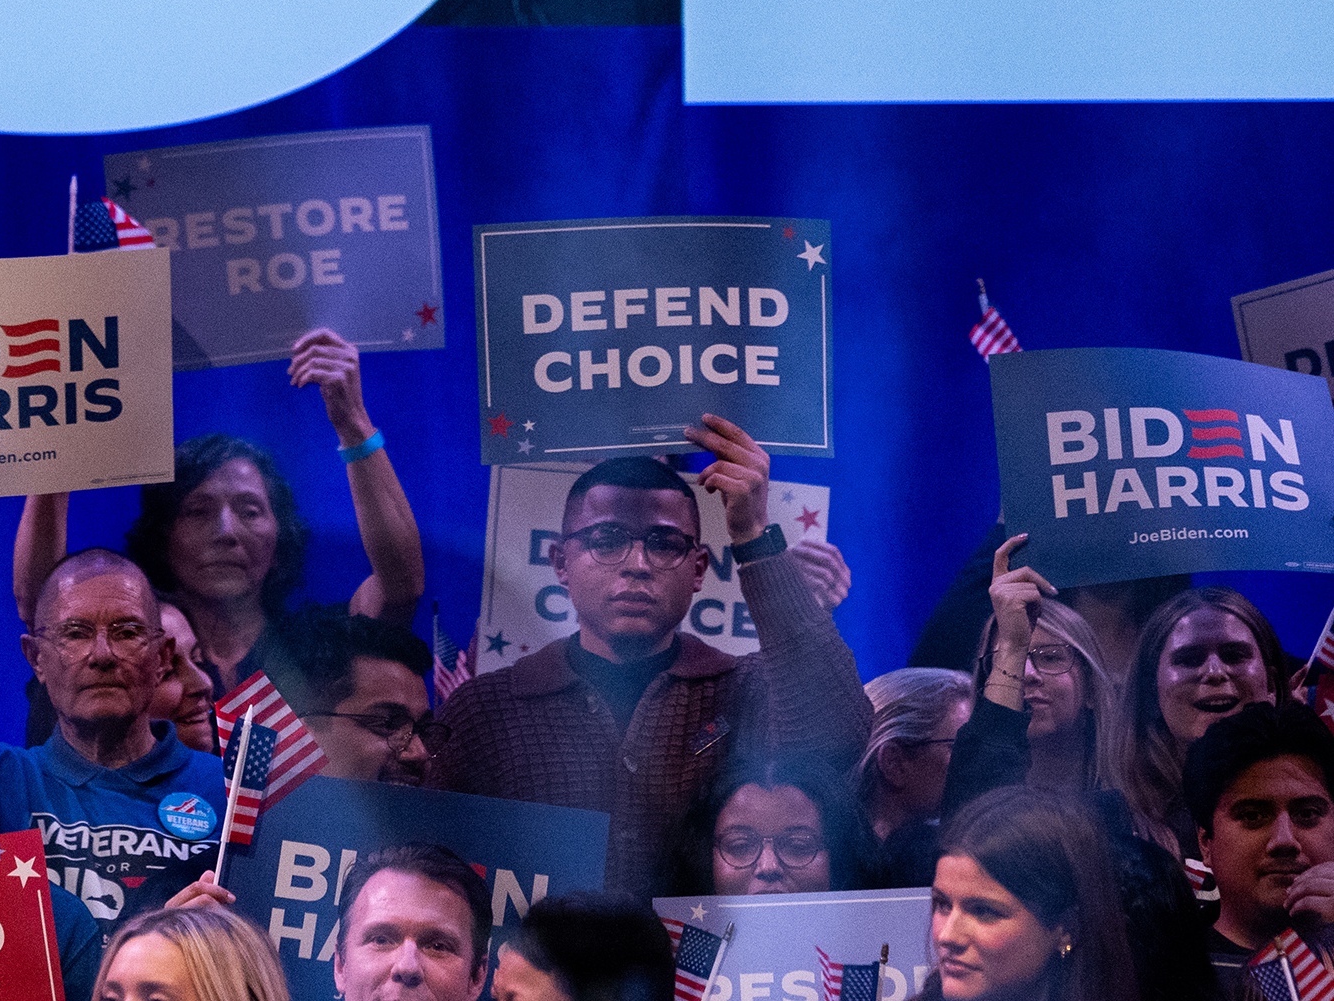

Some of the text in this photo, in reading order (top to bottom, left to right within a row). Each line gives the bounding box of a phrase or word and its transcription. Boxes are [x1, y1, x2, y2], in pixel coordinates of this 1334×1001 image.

[145, 195, 410, 251] RESTORE
[226, 250, 346, 296] ROE
[521, 286, 790, 335] DEFEND
[533, 343, 781, 393] CHOICE
[1045, 406, 1302, 466] BIDEN
[1051, 465, 1311, 519] HARRIS
[1129, 527, 1249, 544] JoeBiden.com
[166, 814, 209, 829] VETERANS
